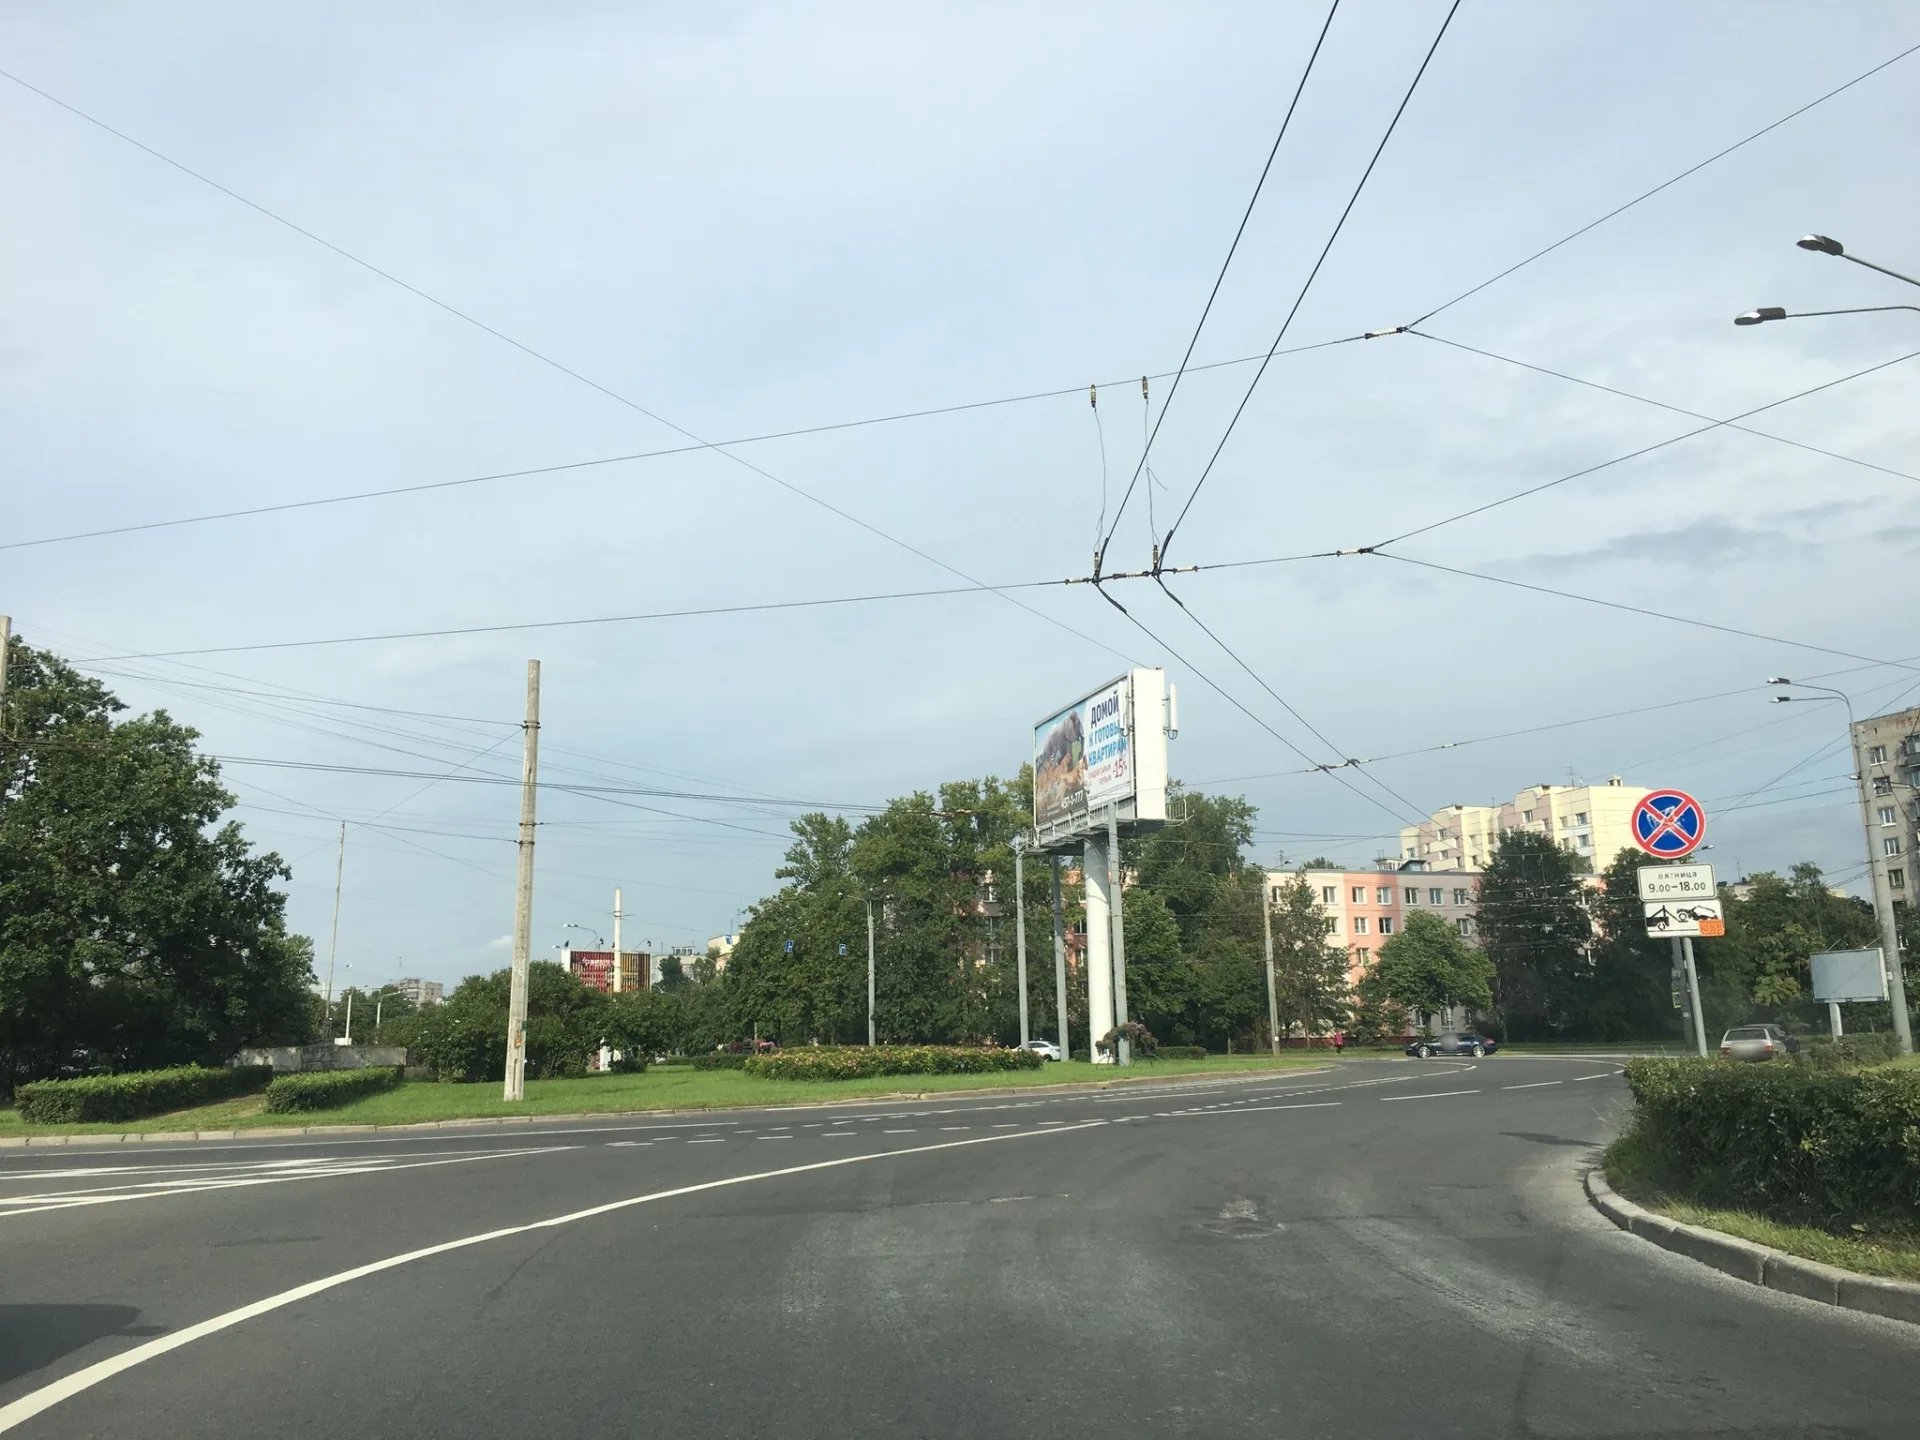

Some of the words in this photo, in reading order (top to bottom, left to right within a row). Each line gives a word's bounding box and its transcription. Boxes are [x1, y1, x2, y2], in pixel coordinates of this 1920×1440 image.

[1091, 690, 1119, 729] ДОМОЙ
[1088, 731, 1094, 748] К
[1094, 719, 1121, 745] ГОТОВЫ
[1088, 737, 1127, 767] КВАРТИРАМ
[1648, 881, 1706, 893] 9.00-18.00
[1658, 871, 1698, 880] пятница
